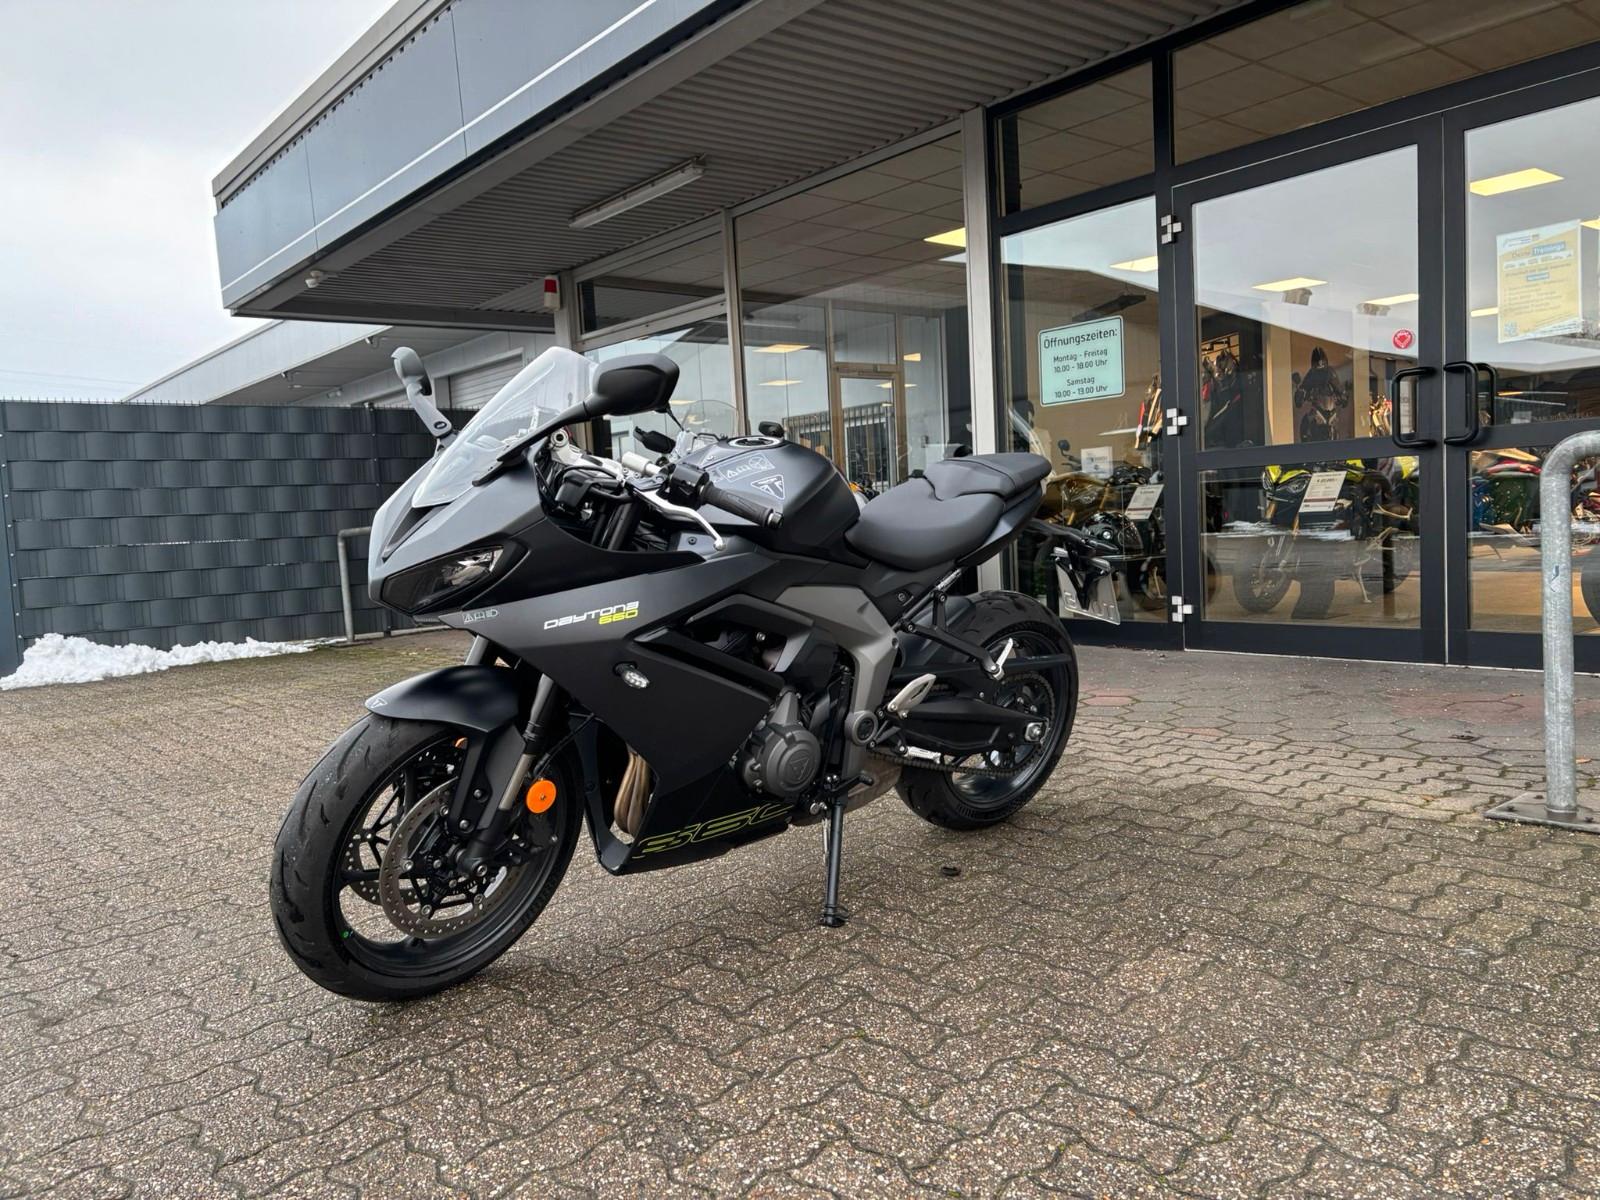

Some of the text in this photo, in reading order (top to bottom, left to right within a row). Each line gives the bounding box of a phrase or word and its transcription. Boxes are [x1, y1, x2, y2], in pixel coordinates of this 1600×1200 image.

[1043, 328, 1118, 349] Öffnungszeiten:
[1053, 353, 1078, 363] Montag
[1084, 348, 1108, 358] Freitag
[1053, 364, 1071, 373] 10.00
[1076, 361, 1094, 370] 18.00
[1095, 359, 1108, 367] Uhr
[1066, 376, 1095, 386] Samstag
[1054, 389, 1071, 398] 10.00
[1077, 386, 1094, 395] 13.00
[1095, 385, 1108, 393] Uhr
[598, 608, 639, 625] 660
